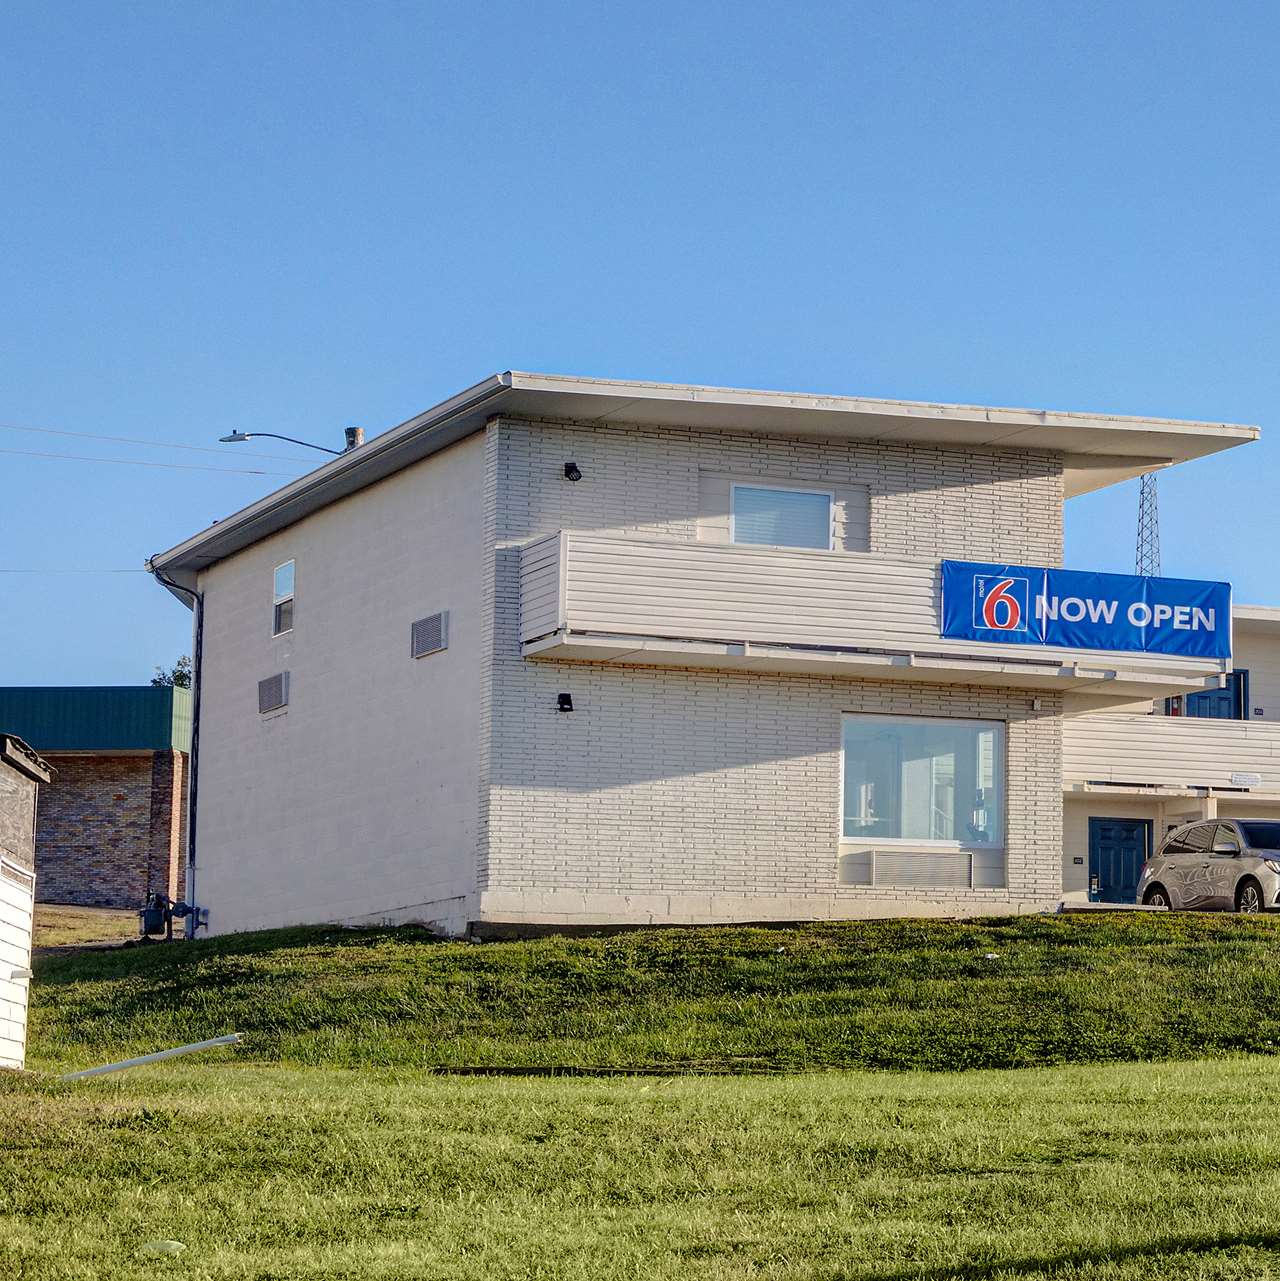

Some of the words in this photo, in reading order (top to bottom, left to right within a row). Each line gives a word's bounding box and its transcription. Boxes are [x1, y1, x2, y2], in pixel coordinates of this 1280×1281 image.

[983, 579, 1021, 630] 6
[1035, 594, 1119, 624] NOW
[1127, 602, 1216, 632] OPEN
